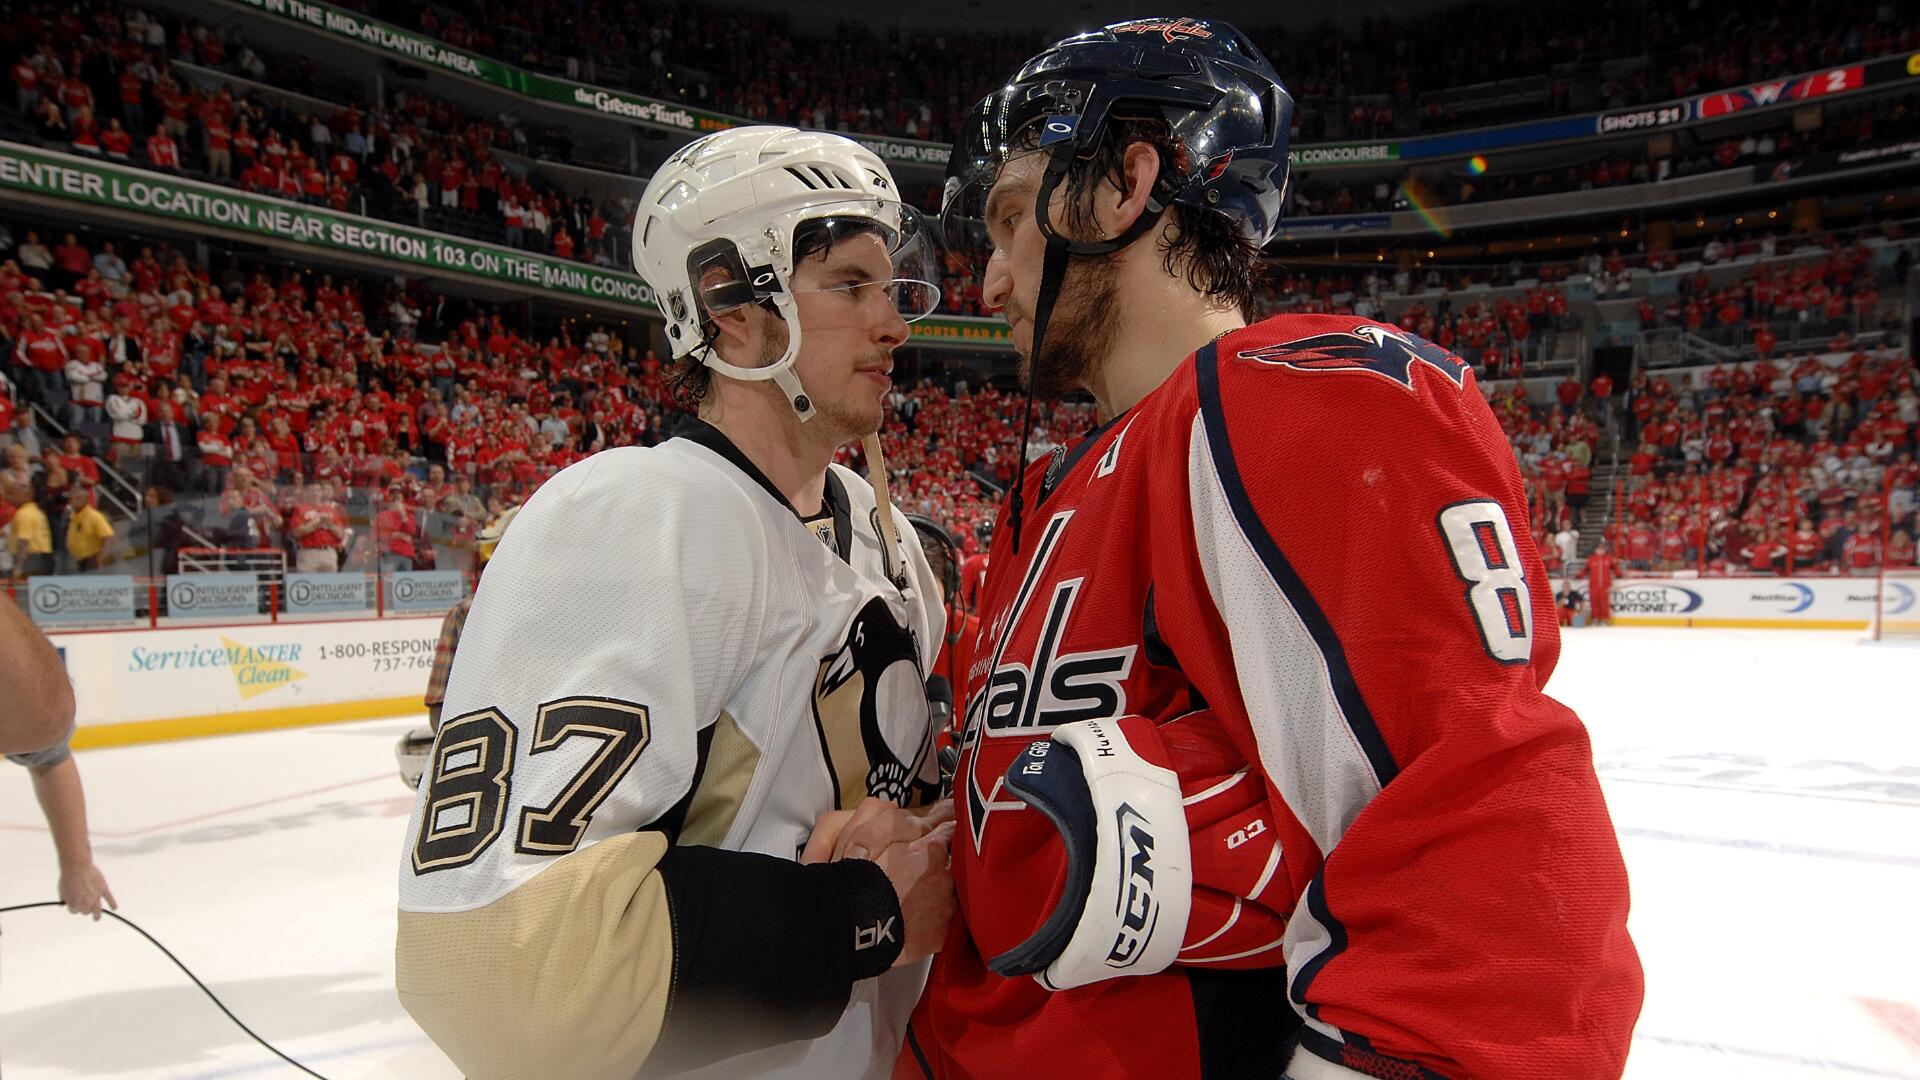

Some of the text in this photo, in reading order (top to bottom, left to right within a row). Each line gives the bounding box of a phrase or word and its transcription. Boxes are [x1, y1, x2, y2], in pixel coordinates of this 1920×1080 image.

[290, 0, 323, 25] THE
[326, 11, 436, 61] MID-ATLANTIC
[1826, 70, 1847, 92] 2
[574, 87, 594, 105] the
[594, 92, 650, 120] Greene
[650, 102, 694, 129] Turtle
[1602, 106, 1680, 132] SHOTS 21
[890, 144, 917, 159] OUR
[1302, 145, 1389, 161] CONCOURSE
[112, 178, 250, 226] LOCATION
[257, 209, 325, 241] NEAR
[331, 223, 428, 259] SECTION
[433, 243, 466, 267] 103
[470, 251, 499, 274] ON
[504, 258, 541, 282] THE
[544, 266, 588, 290] MAIN
[194, 584, 255, 595] INTELLIGENT
[310, 583, 362, 592] INTELLIGENT
[413, 581, 459, 590] INTELLIGENT
[1436, 498, 1535, 665] 8
[61, 587, 129, 598] INTELLIGENT
[195, 594, 247, 604] DECISIONS
[310, 591, 356, 600] DECISIONS
[413, 589, 454, 597] DECISIONS
[62, 598, 121, 608] DECISIONS
[128, 643, 302, 672] ServiceMASTER
[238, 666, 291, 686] Clean
[411, 696, 651, 876] 87
[1105, 822, 1157, 965] CCM
